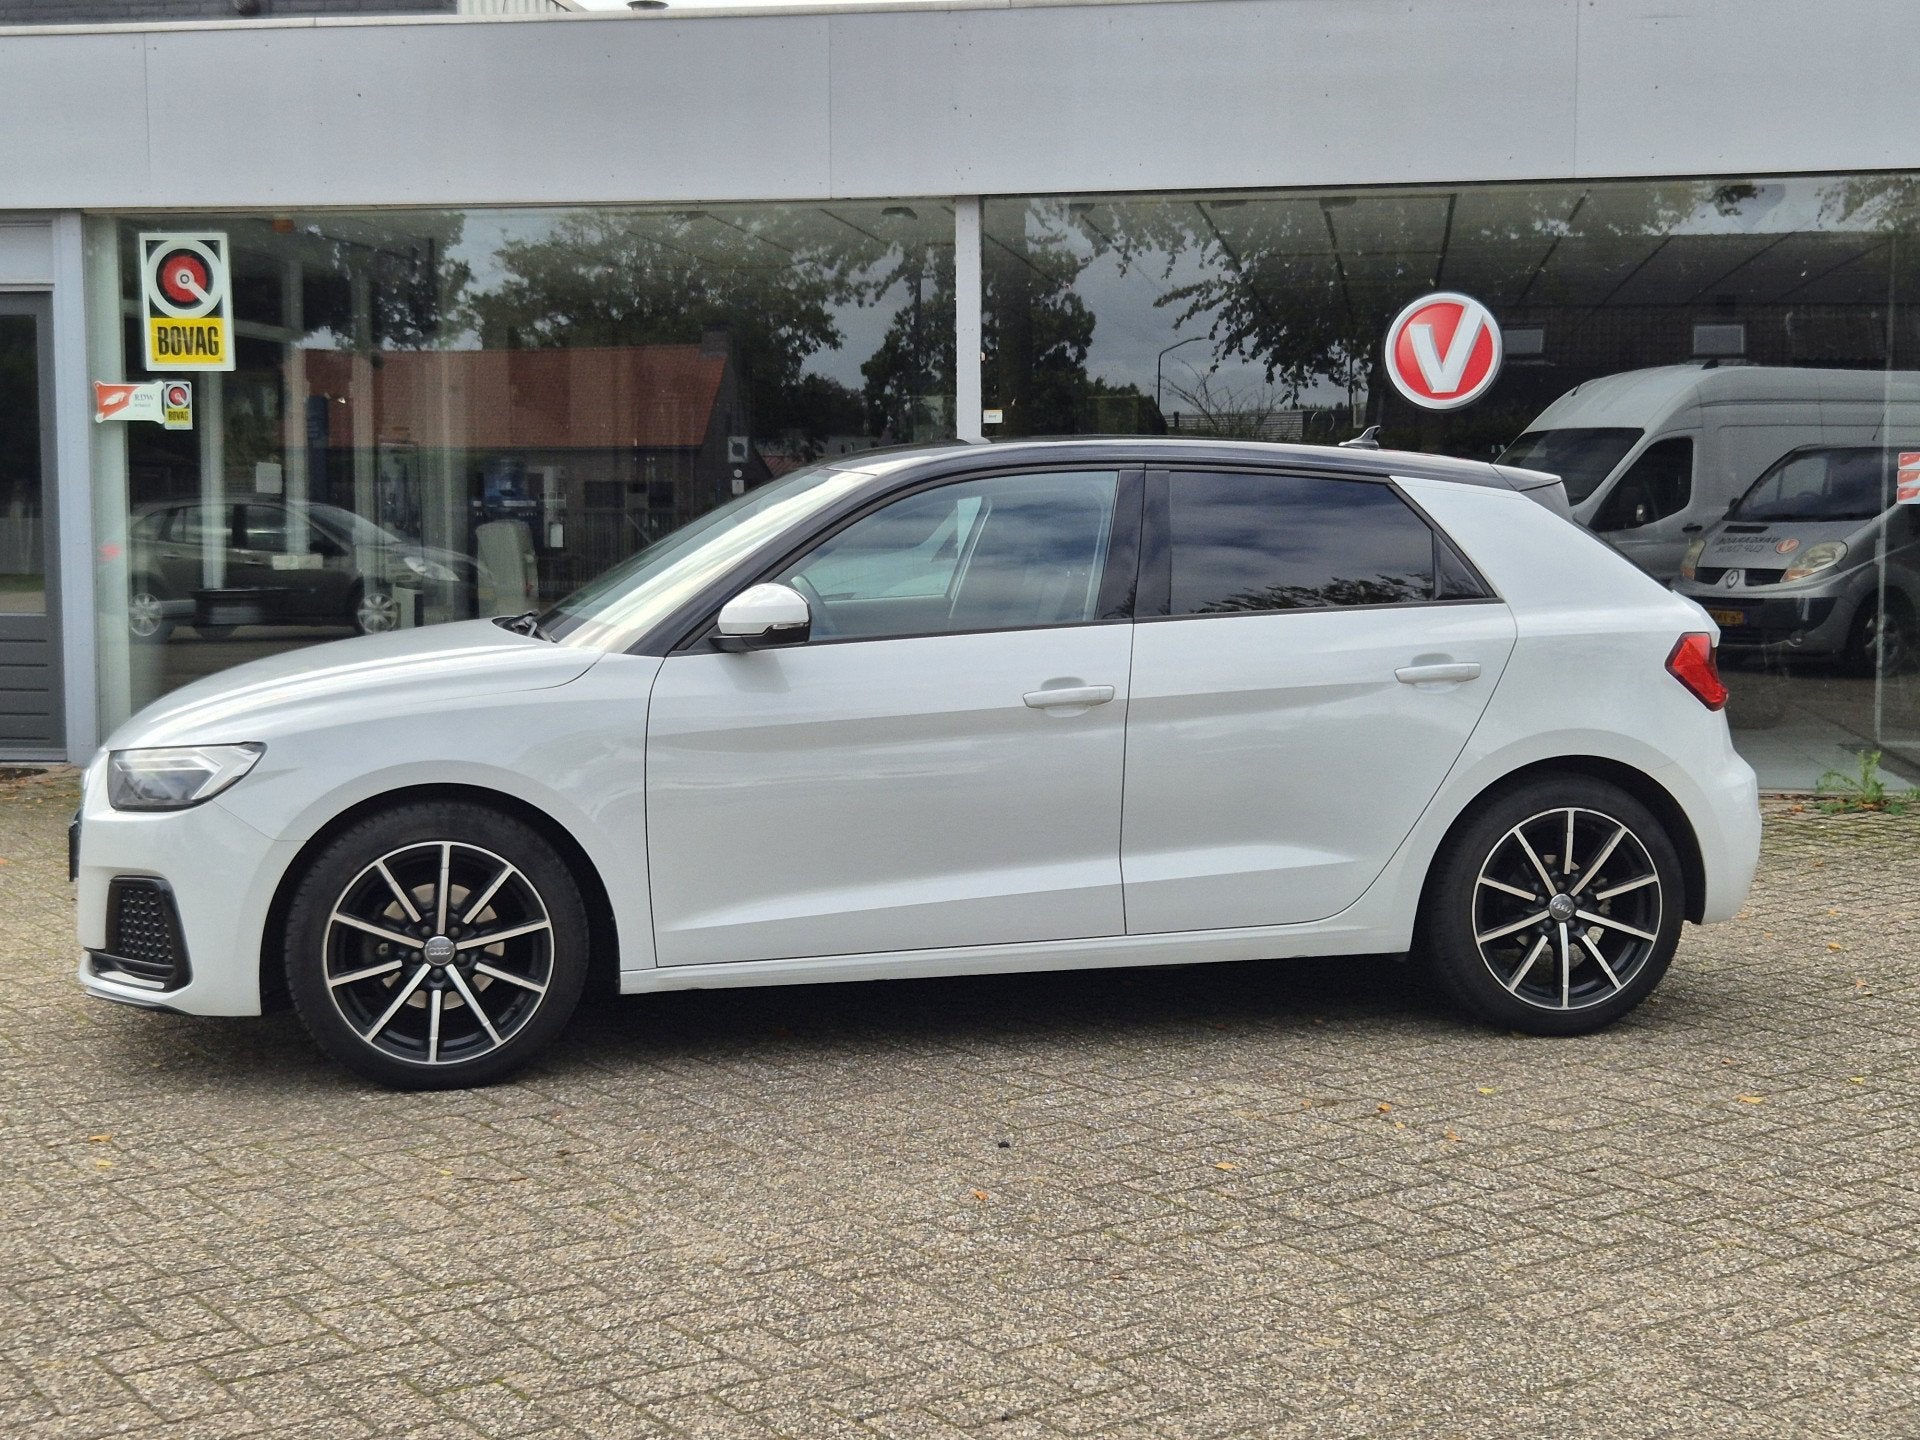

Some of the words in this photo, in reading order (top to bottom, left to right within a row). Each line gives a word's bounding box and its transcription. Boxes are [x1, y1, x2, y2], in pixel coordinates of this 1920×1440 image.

[157, 326, 219, 356] BOVAG
[1409, 303, 1483, 393] V
[134, 393, 154, 401] RDW
[168, 410, 189, 421] BOVAG
